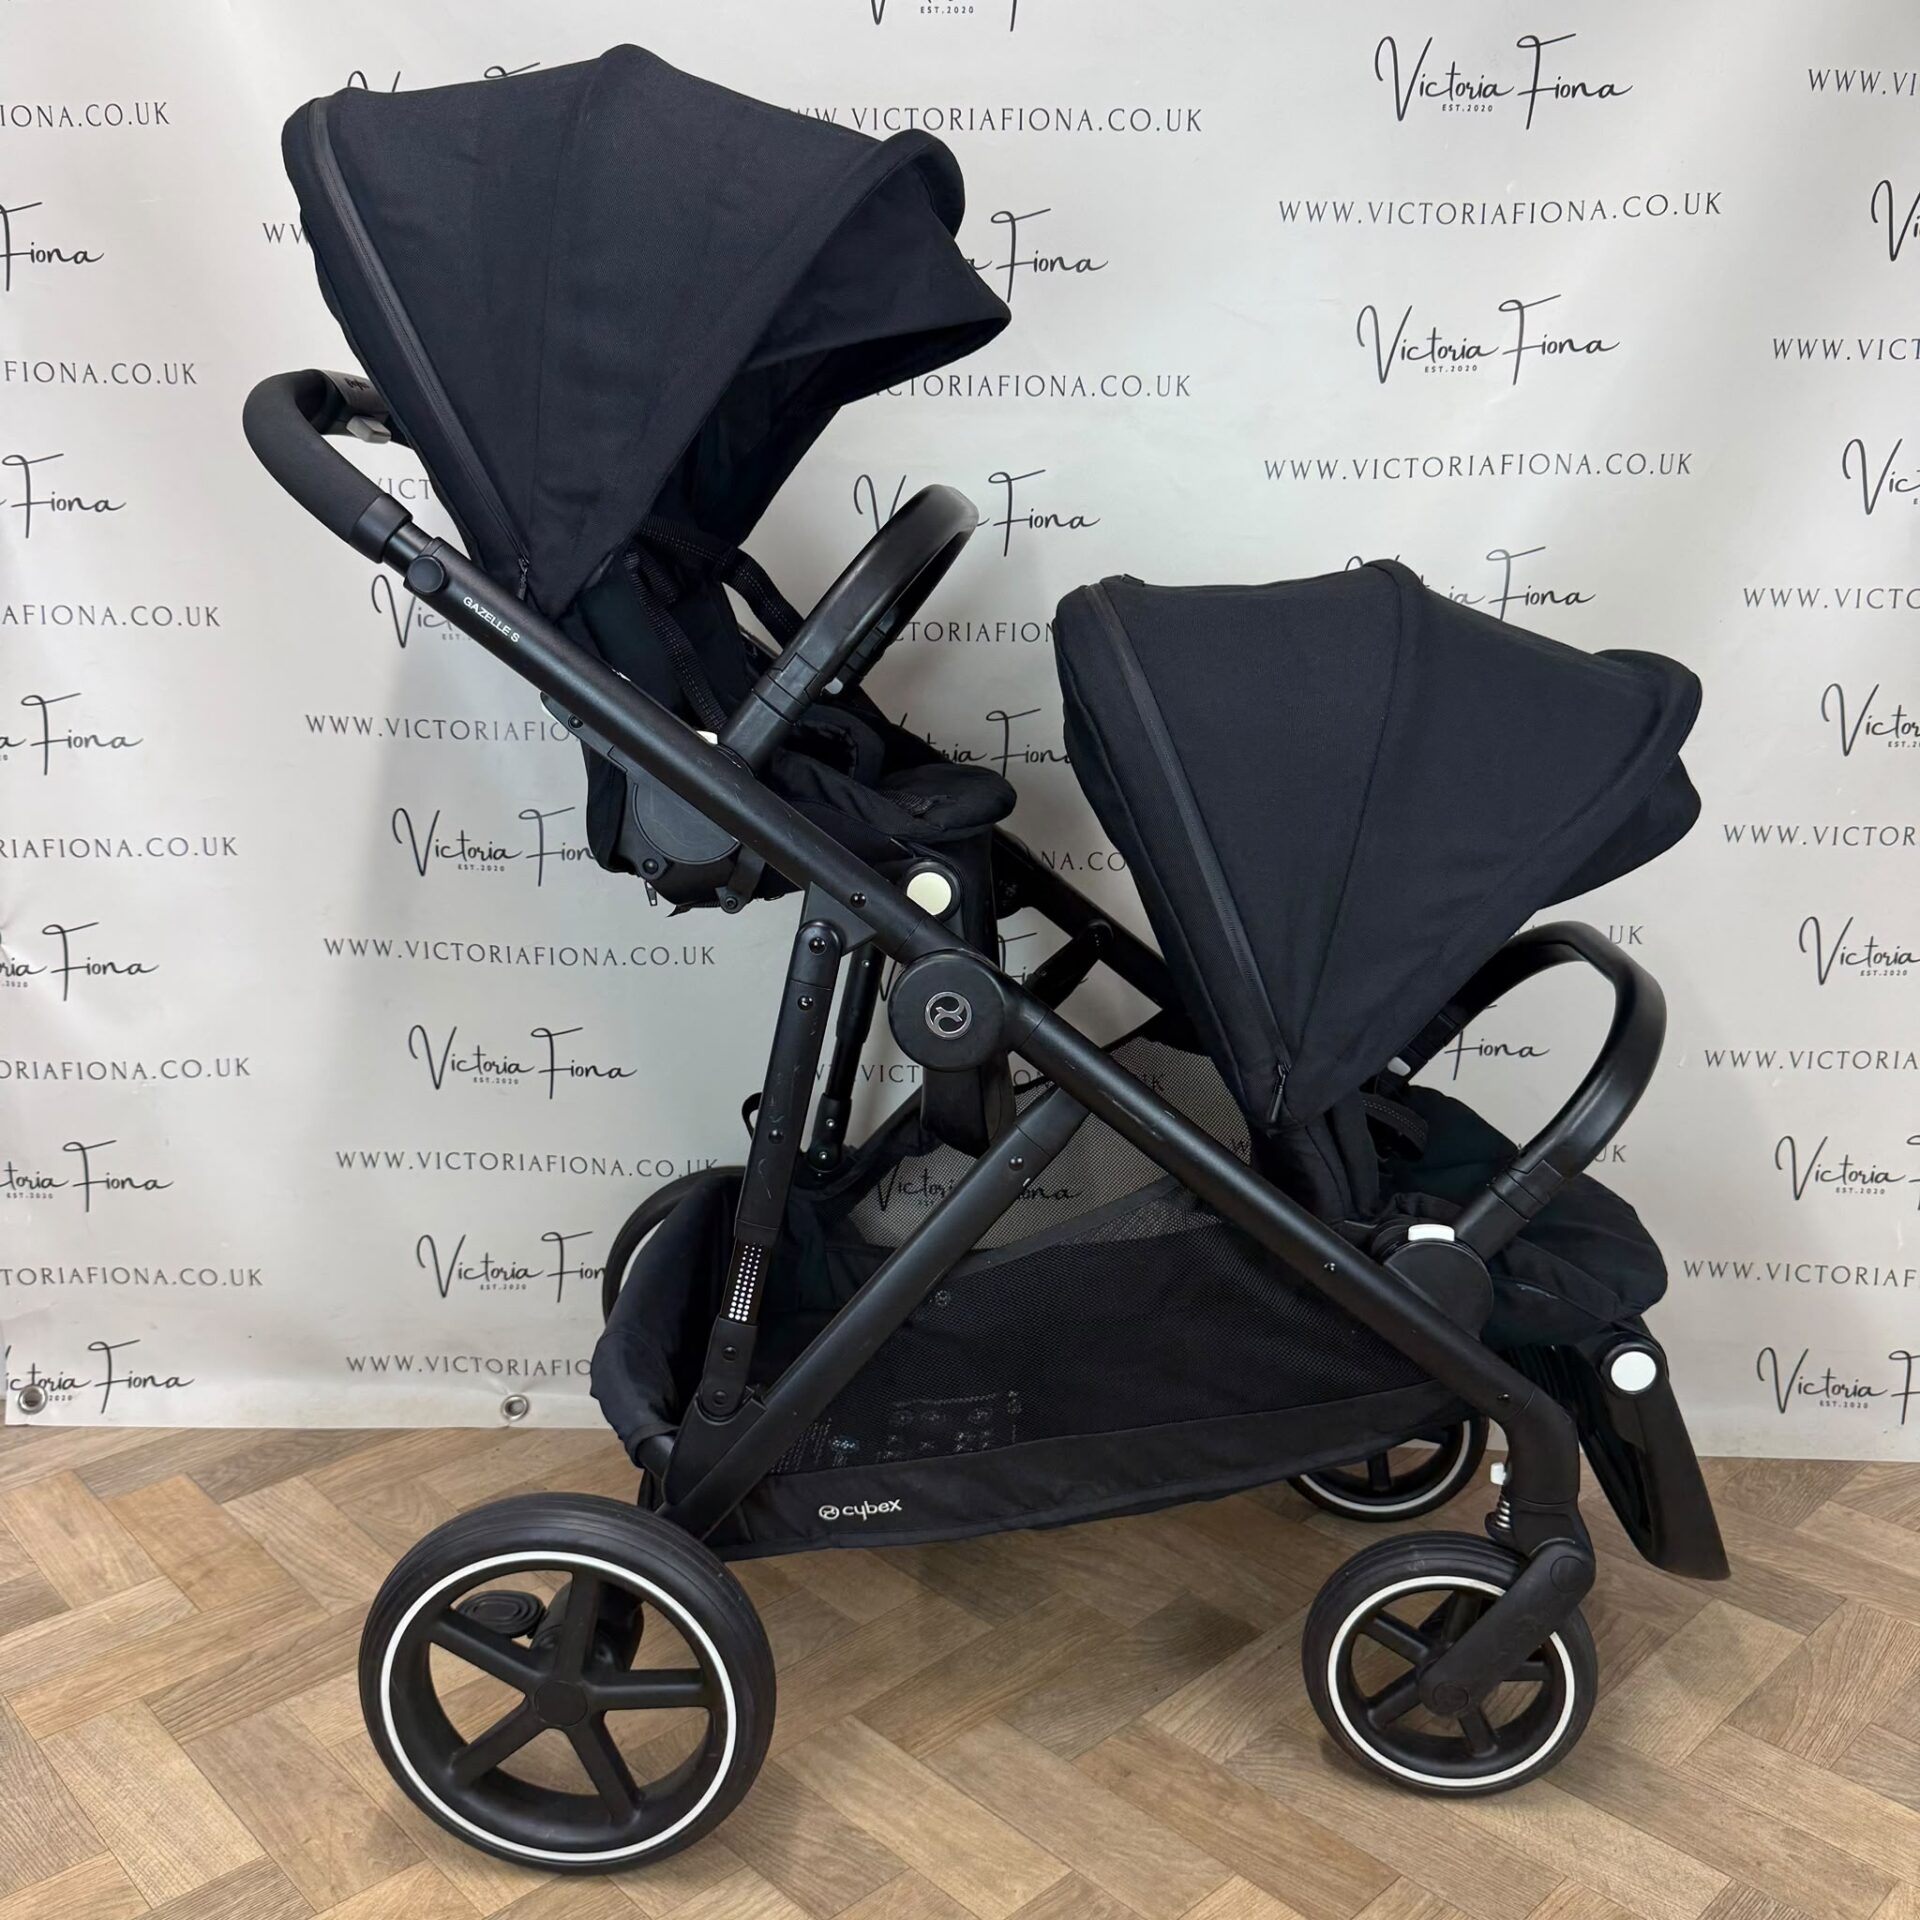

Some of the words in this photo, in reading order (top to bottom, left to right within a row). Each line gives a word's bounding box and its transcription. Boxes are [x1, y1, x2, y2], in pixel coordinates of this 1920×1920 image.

[920, 5, 975, 15] EST.2020
[1373, 35, 1515, 122] Victoria
[1516, 32, 1634, 130] Fiona
[1807, 68, 1918, 97] WWW.VI
[1441, 103, 1494, 112] EST.2020
[1278, 191, 1723, 225] WWW.VICTORIAFIONA.CO.UK
[990, 207, 1109, 303] Fiona
[1356, 304, 1500, 384] Victoria
[1498, 293, 1620, 386] Fiona
[3, 359, 199, 386] FIONA.CO.UK
[1424, 364, 1478, 373] EST.2020
[1263, 452, 1693, 481] WWW.VICTORIAFIONA.CO.UK
[1, 452, 127, 539] Fiona
[987, 468, 1101, 557] Fiona
[1485, 545, 1596, 621] Fiona
[1, 604, 222, 627] AFIONA.CO.UK
[463, 596, 512, 637] GAZELLE
[510, 632, 520, 643] S
[20, 692, 144, 776] Fiona
[392, 807, 523, 877] Victoria
[1723, 823, 1917, 847] WWW.VICTOR
[457, 863, 506, 872] EST.2020
[41, 920, 160, 1002] Fiona
[322, 937, 717, 967] WWW.VICTORIAFIONA.CO.UK
[1798, 915, 1920, 986] Victoria
[1859, 969, 1909, 977] EST.2020
[408, 1024, 536, 1091] Victoria
[530, 1027, 638, 1100] Fiona
[1704, 1049, 1919, 1070] WWW.VICTORIA
[472, 1076, 520, 1086] EST.2020
[62, 1138, 175, 1214] Fiona
[1774, 1135, 1906, 1201] Victoria
[1835, 1186, 1886, 1195] EST.2020
[416, 1234, 545, 1299] Victoria
[479, 1283, 528, 1292] EST.2020
[87, 1338, 196, 1415] Fiona
[1756, 1347, 1889, 1415] Victoria
[1818, 1400, 1870, 1410] EST.2020
[841, 1499, 903, 1521] cybex
